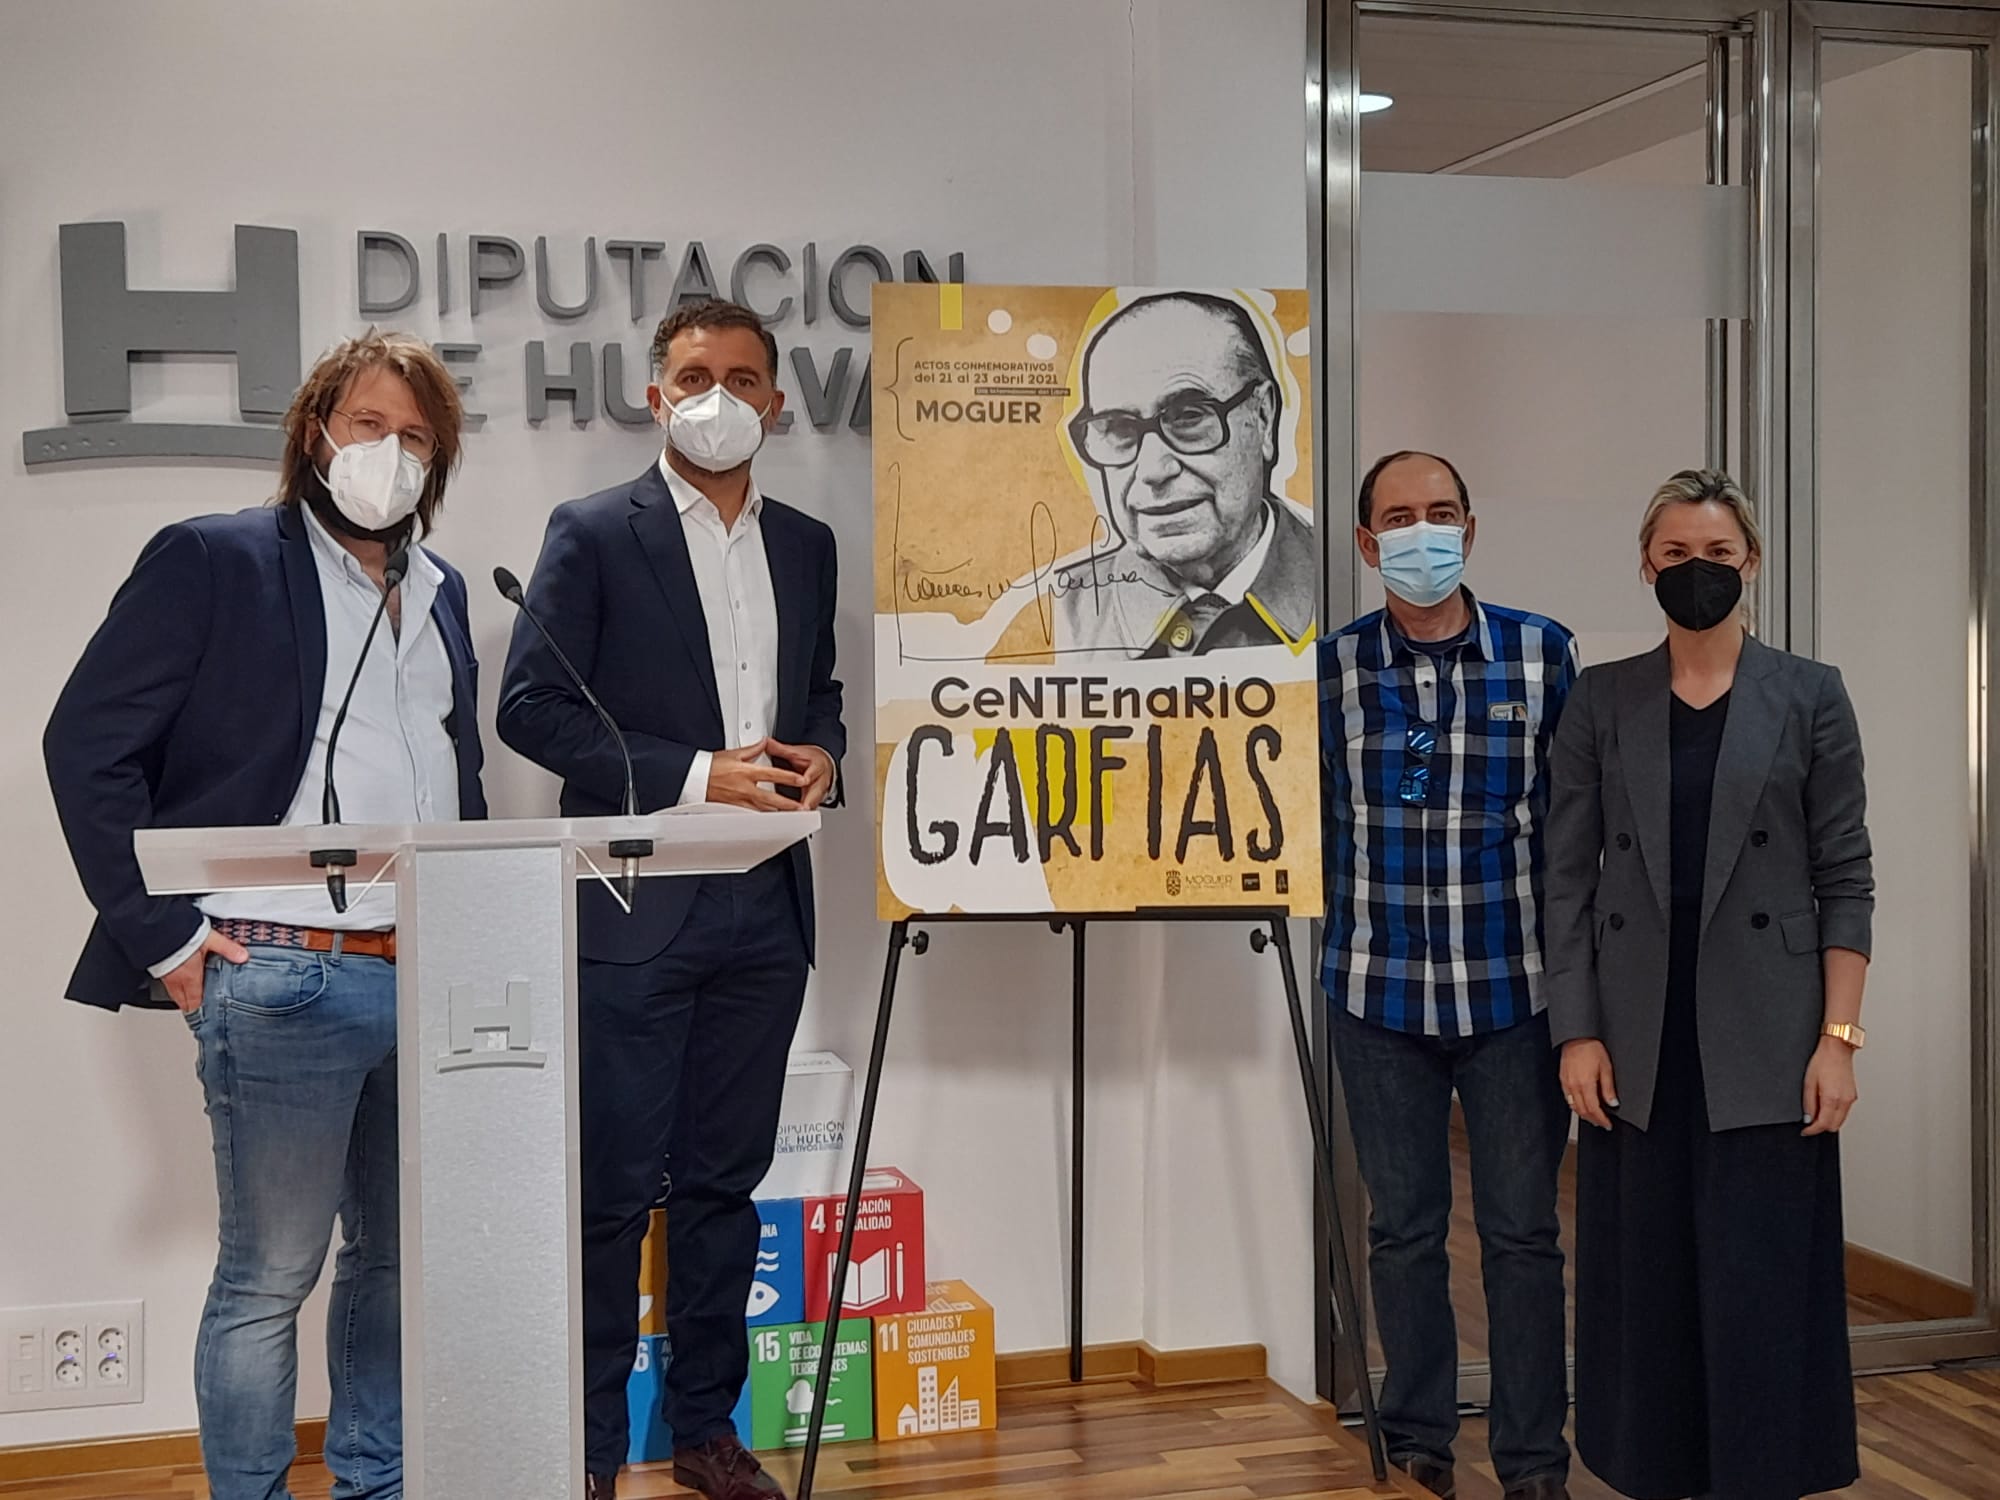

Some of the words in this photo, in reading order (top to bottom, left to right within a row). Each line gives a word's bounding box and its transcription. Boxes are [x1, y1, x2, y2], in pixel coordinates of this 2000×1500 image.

[914, 361, 951, 371] ACTOS
[953, 361, 1055, 373] CONMEMORATIVOS
[914, 372, 936, 384] del
[938, 373, 953, 384] 21
[957, 373, 970, 384] al
[974, 373, 989, 385] 23
[993, 374, 1024, 386] abril
[1028, 374, 1059, 386] 2021
[915, 400, 1042, 424] MOGUER
[906, 723, 1285, 866] GARFIAS
[797, 1132, 844, 1145] HUELVA
[810, 1203, 826, 1233] 4
[907, 1315, 955, 1334] CIUDADES
[955, 1314, 962, 1329] Y
[754, 1331, 781, 1363] 15
[789, 1330, 812, 1345] VIDA
[878, 1321, 899, 1353] 11
[907, 1328, 976, 1350] COMUNIDADES
[789, 1346, 802, 1361] DE
[907, 1344, 970, 1365] SOSTENIBLES
